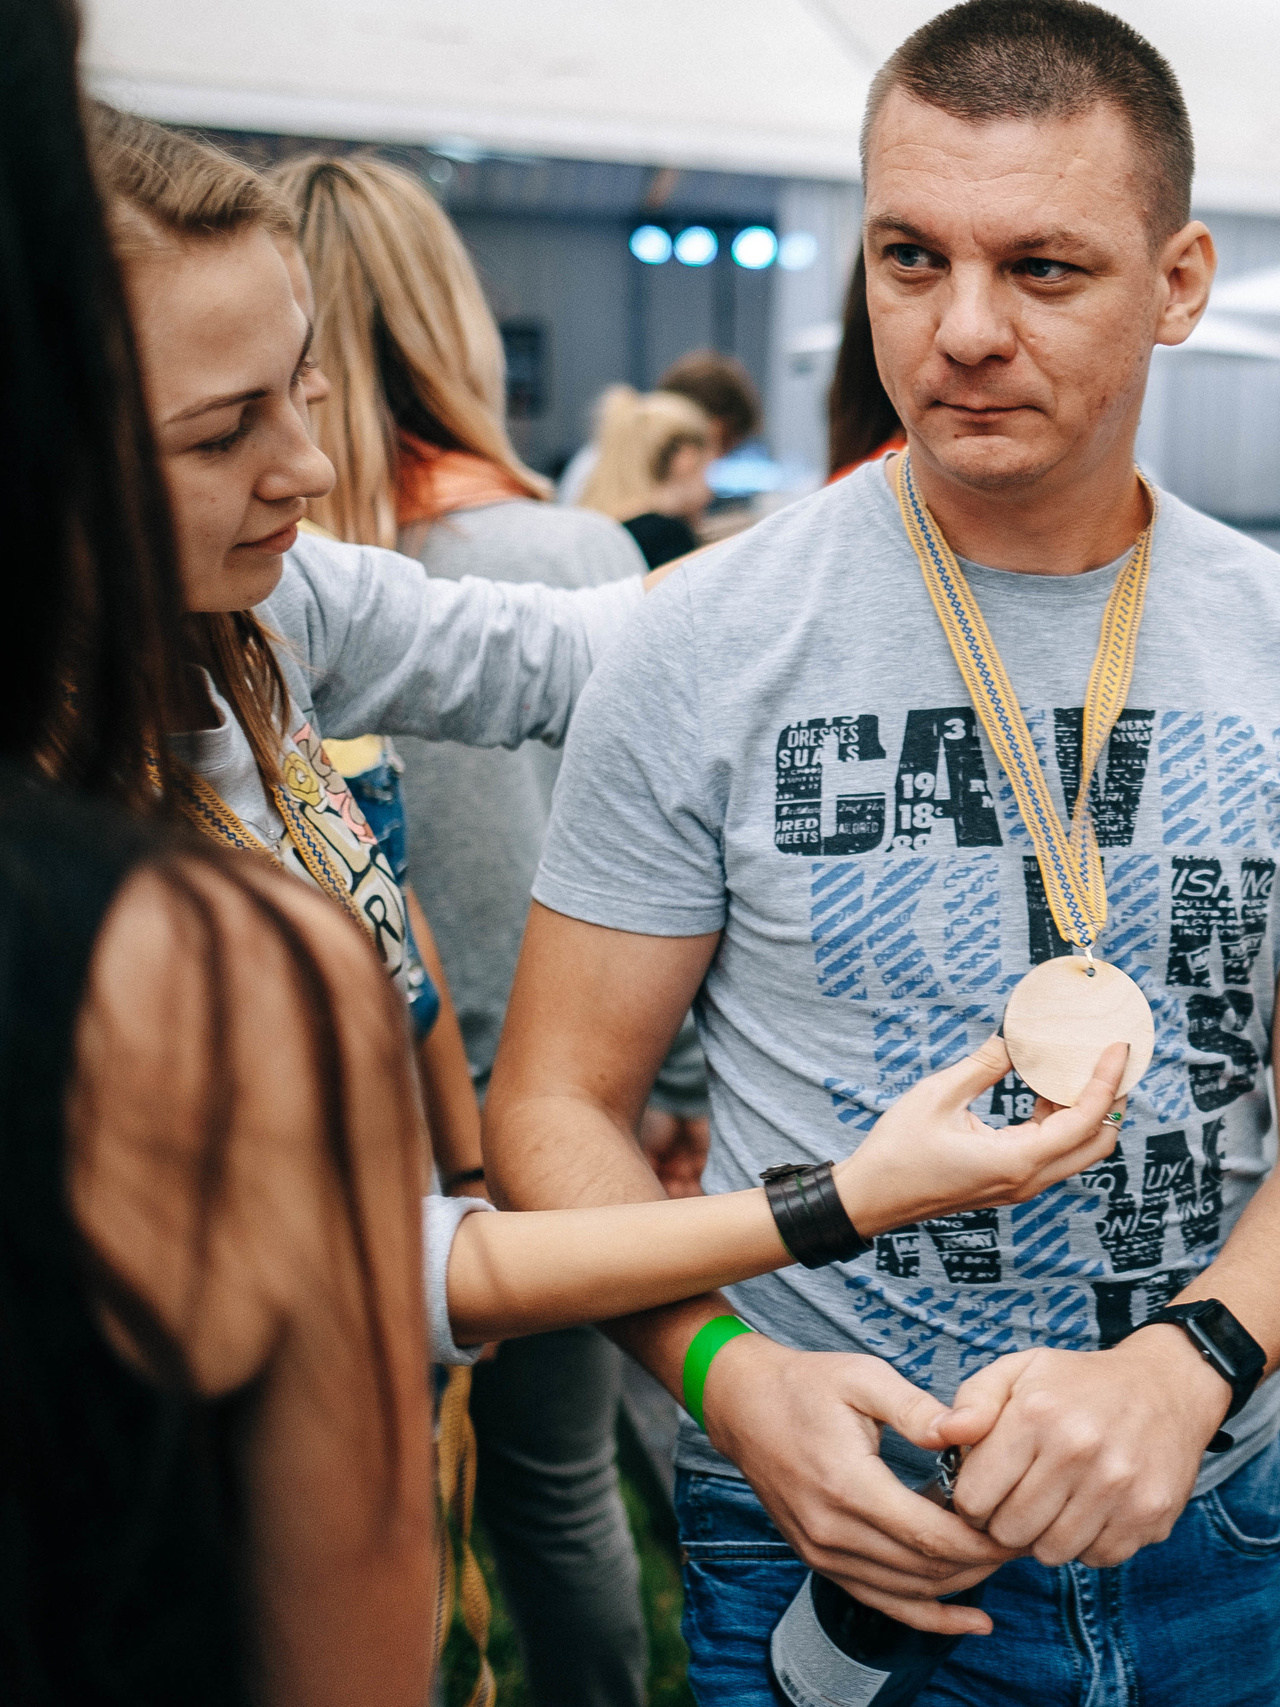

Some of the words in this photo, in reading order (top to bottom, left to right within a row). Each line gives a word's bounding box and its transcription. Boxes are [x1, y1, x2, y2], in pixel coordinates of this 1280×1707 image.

[787, 725, 860, 748] DRESSES
[943, 718, 967, 741] 3
[778, 744, 861, 769] SUAS
[900, 772, 936, 799] 19
[1000, 1093, 1036, 1120] 18
